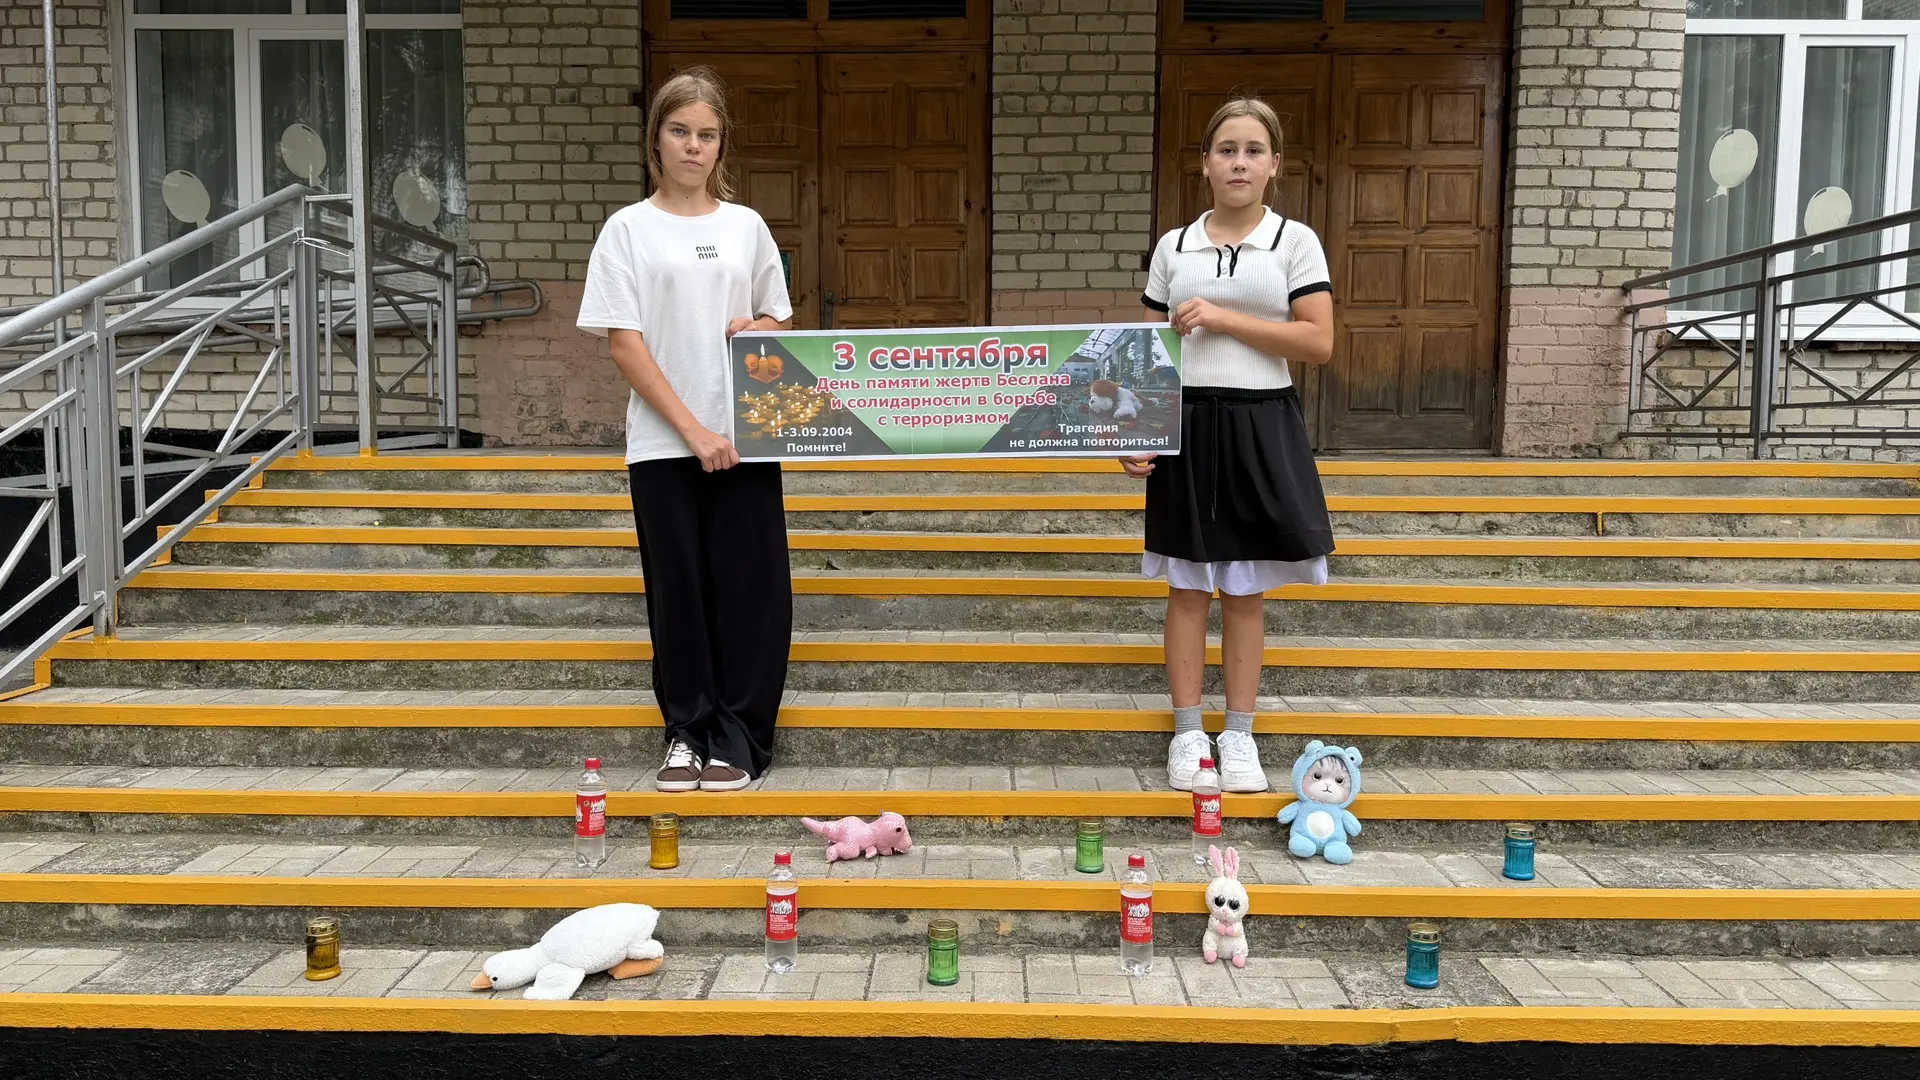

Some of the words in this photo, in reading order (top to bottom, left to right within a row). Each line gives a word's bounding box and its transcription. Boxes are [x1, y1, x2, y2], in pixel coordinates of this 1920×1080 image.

[833, 342, 856, 371] 3
[869, 338, 1048, 374] сентября
[816, 377, 860, 393] День
[866, 376, 930, 390] памяти
[935, 375, 991, 390] жертв
[997, 373, 1070, 388] Беслана
[831, 398, 842, 410] и
[847, 394, 971, 411] солидарности
[977, 393, 987, 406] в
[993, 391, 1057, 408] борьбе
[877, 414, 888, 426] с
[892, 413, 1010, 428] терроризмом
[776, 426, 853, 438] 1-3.09.2004
[1058, 423, 1119, 435] Трагедия
[787, 442, 846, 453] Помните!
[1009, 438, 1027, 448] не
[1029, 437, 1079, 449] должна
[1083, 435, 1169, 448] повториться!
